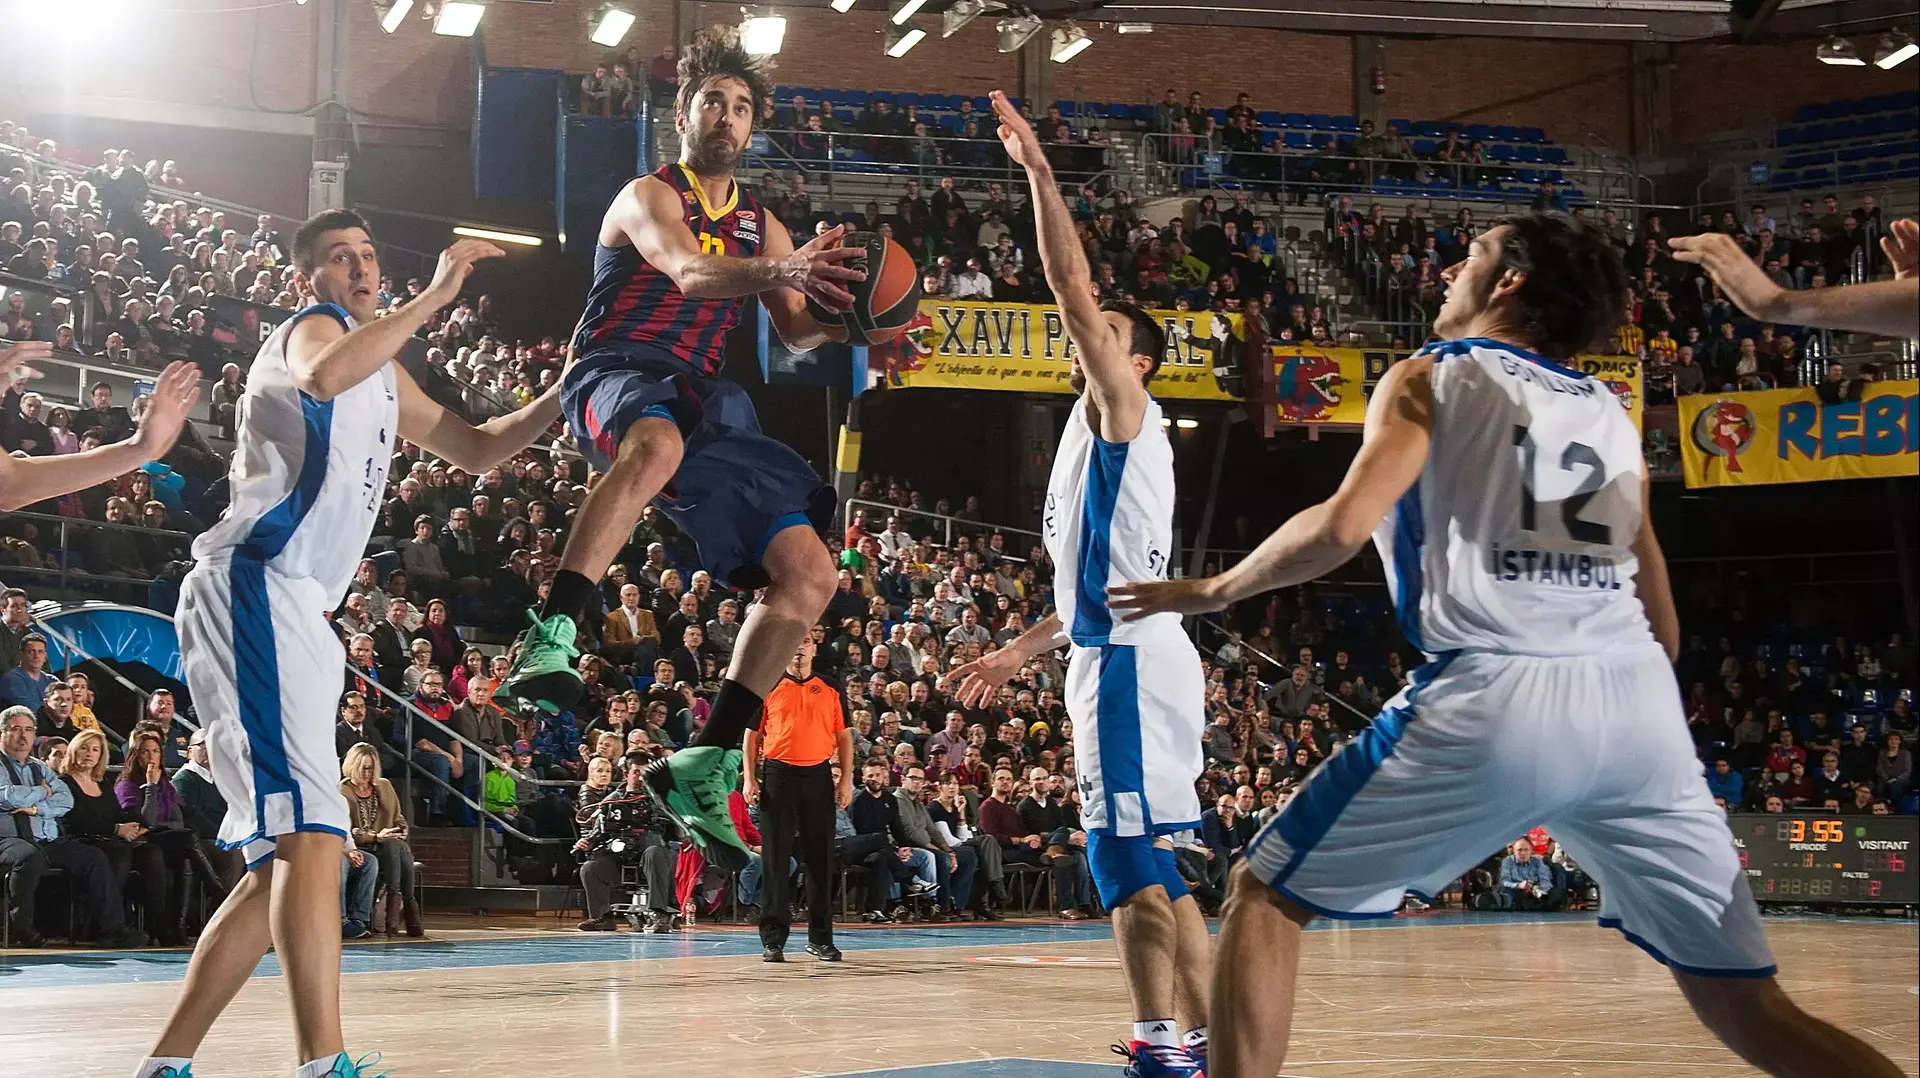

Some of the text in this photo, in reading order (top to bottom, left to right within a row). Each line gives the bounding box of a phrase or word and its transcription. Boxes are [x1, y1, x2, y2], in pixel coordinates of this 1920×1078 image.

[936, 306, 1032, 360] XAVI
[1582, 360, 1638, 378] DRACS
[1512, 424, 1613, 546] 12
[613, 808, 622, 821] 3
[1733, 838, 1746, 848] AL
[1789, 843, 1828, 852] PERIODE
[1858, 840, 1910, 851] VISITANT
[1841, 871, 1870, 880] FALTES
